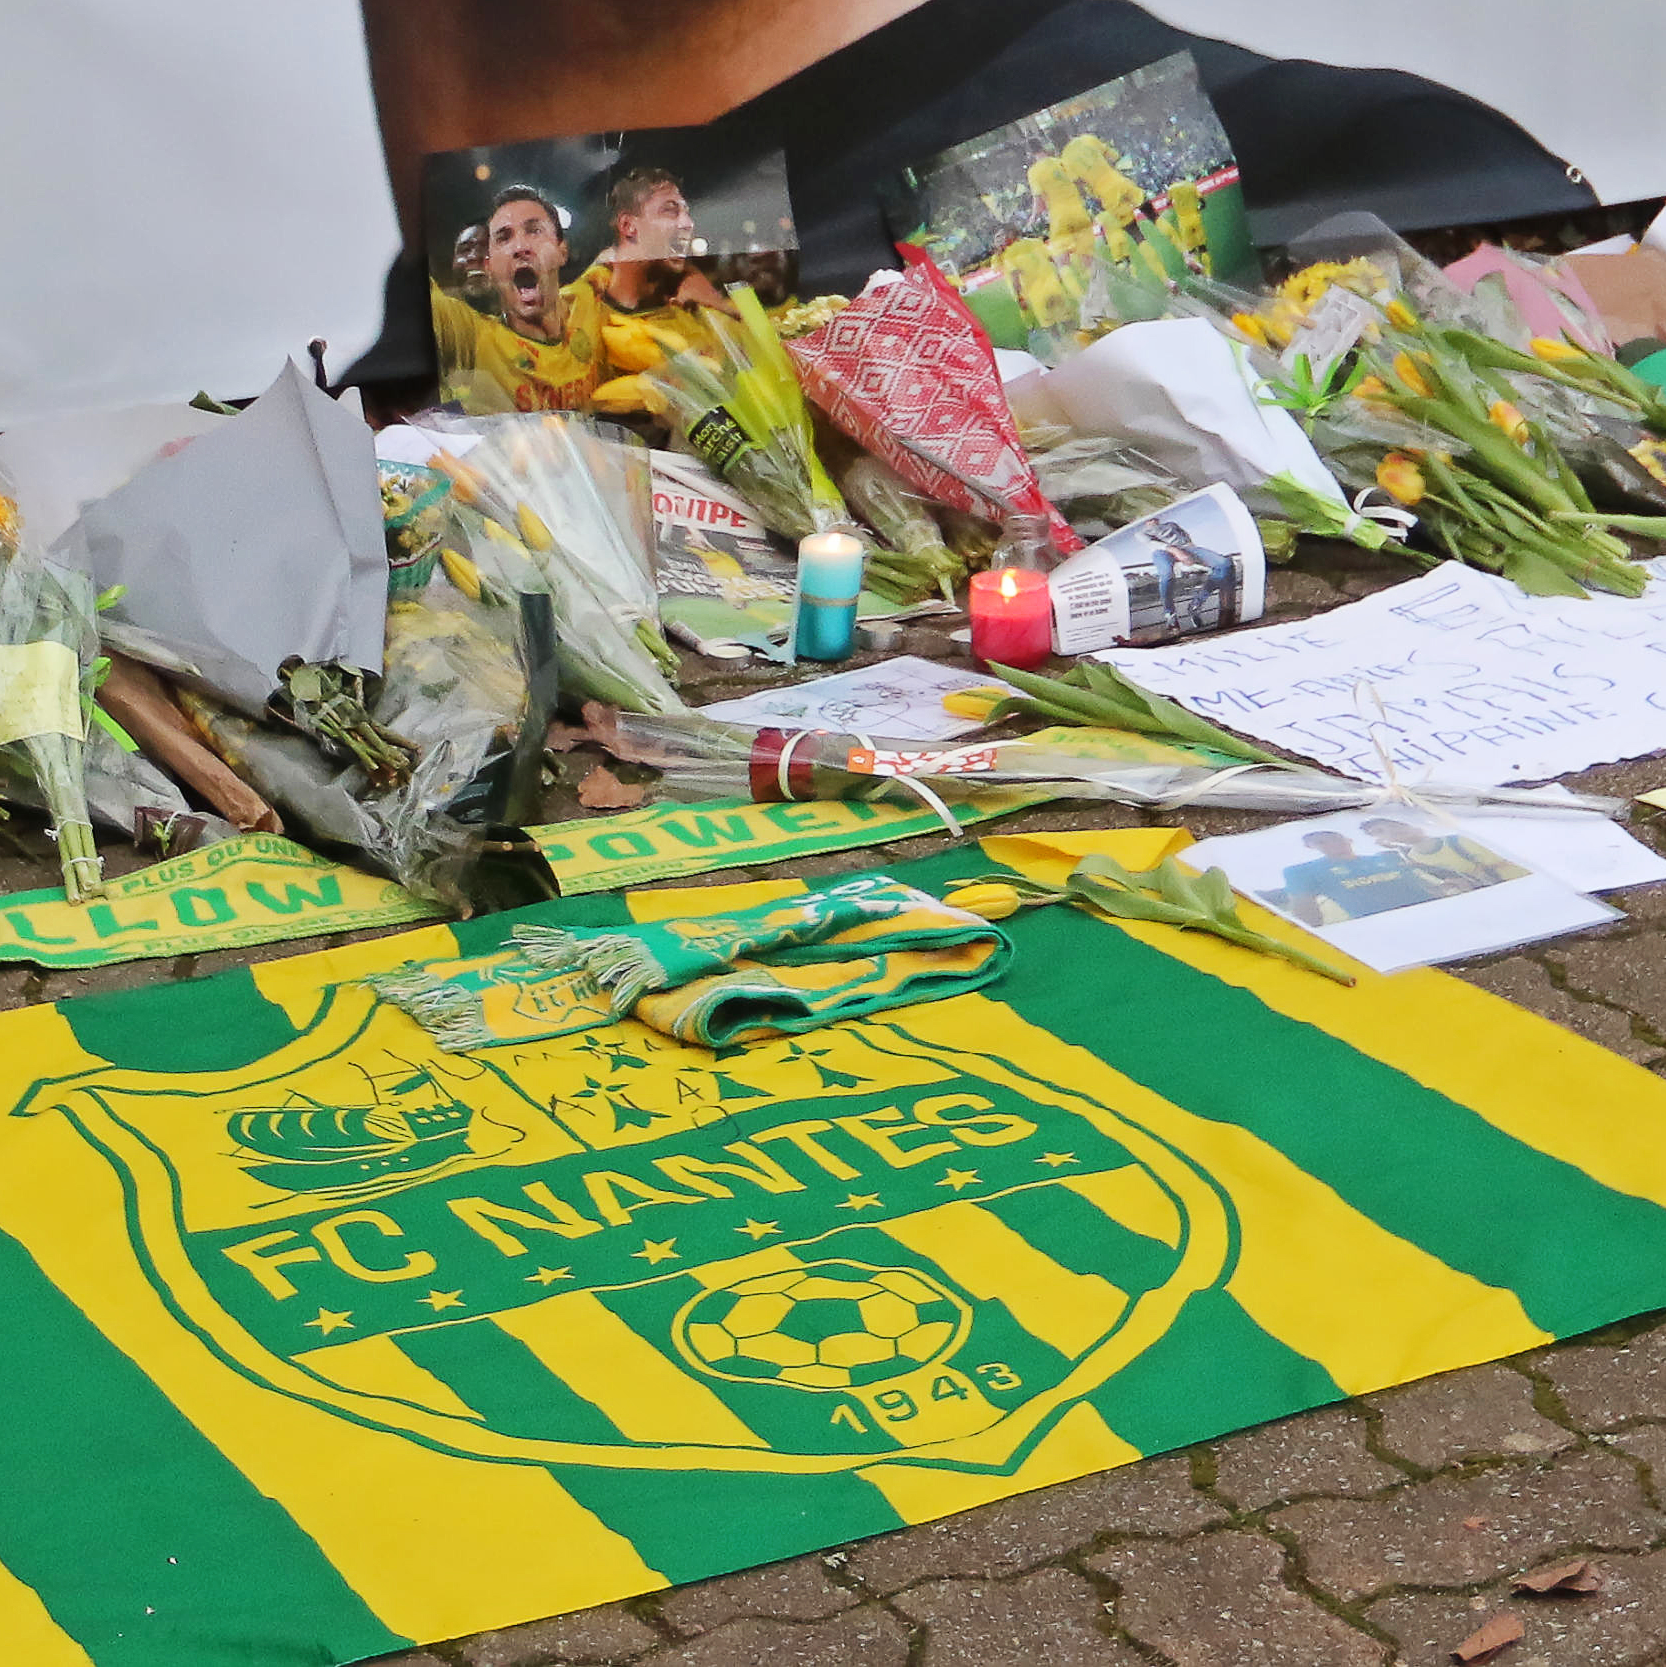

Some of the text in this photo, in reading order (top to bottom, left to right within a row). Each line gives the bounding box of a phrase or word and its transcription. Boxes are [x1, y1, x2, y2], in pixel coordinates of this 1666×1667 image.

[122, 861, 196, 894] PLUS
[224, 1091, 1039, 1302] FC NANTES
[827, 1359, 1024, 1437] 1943
